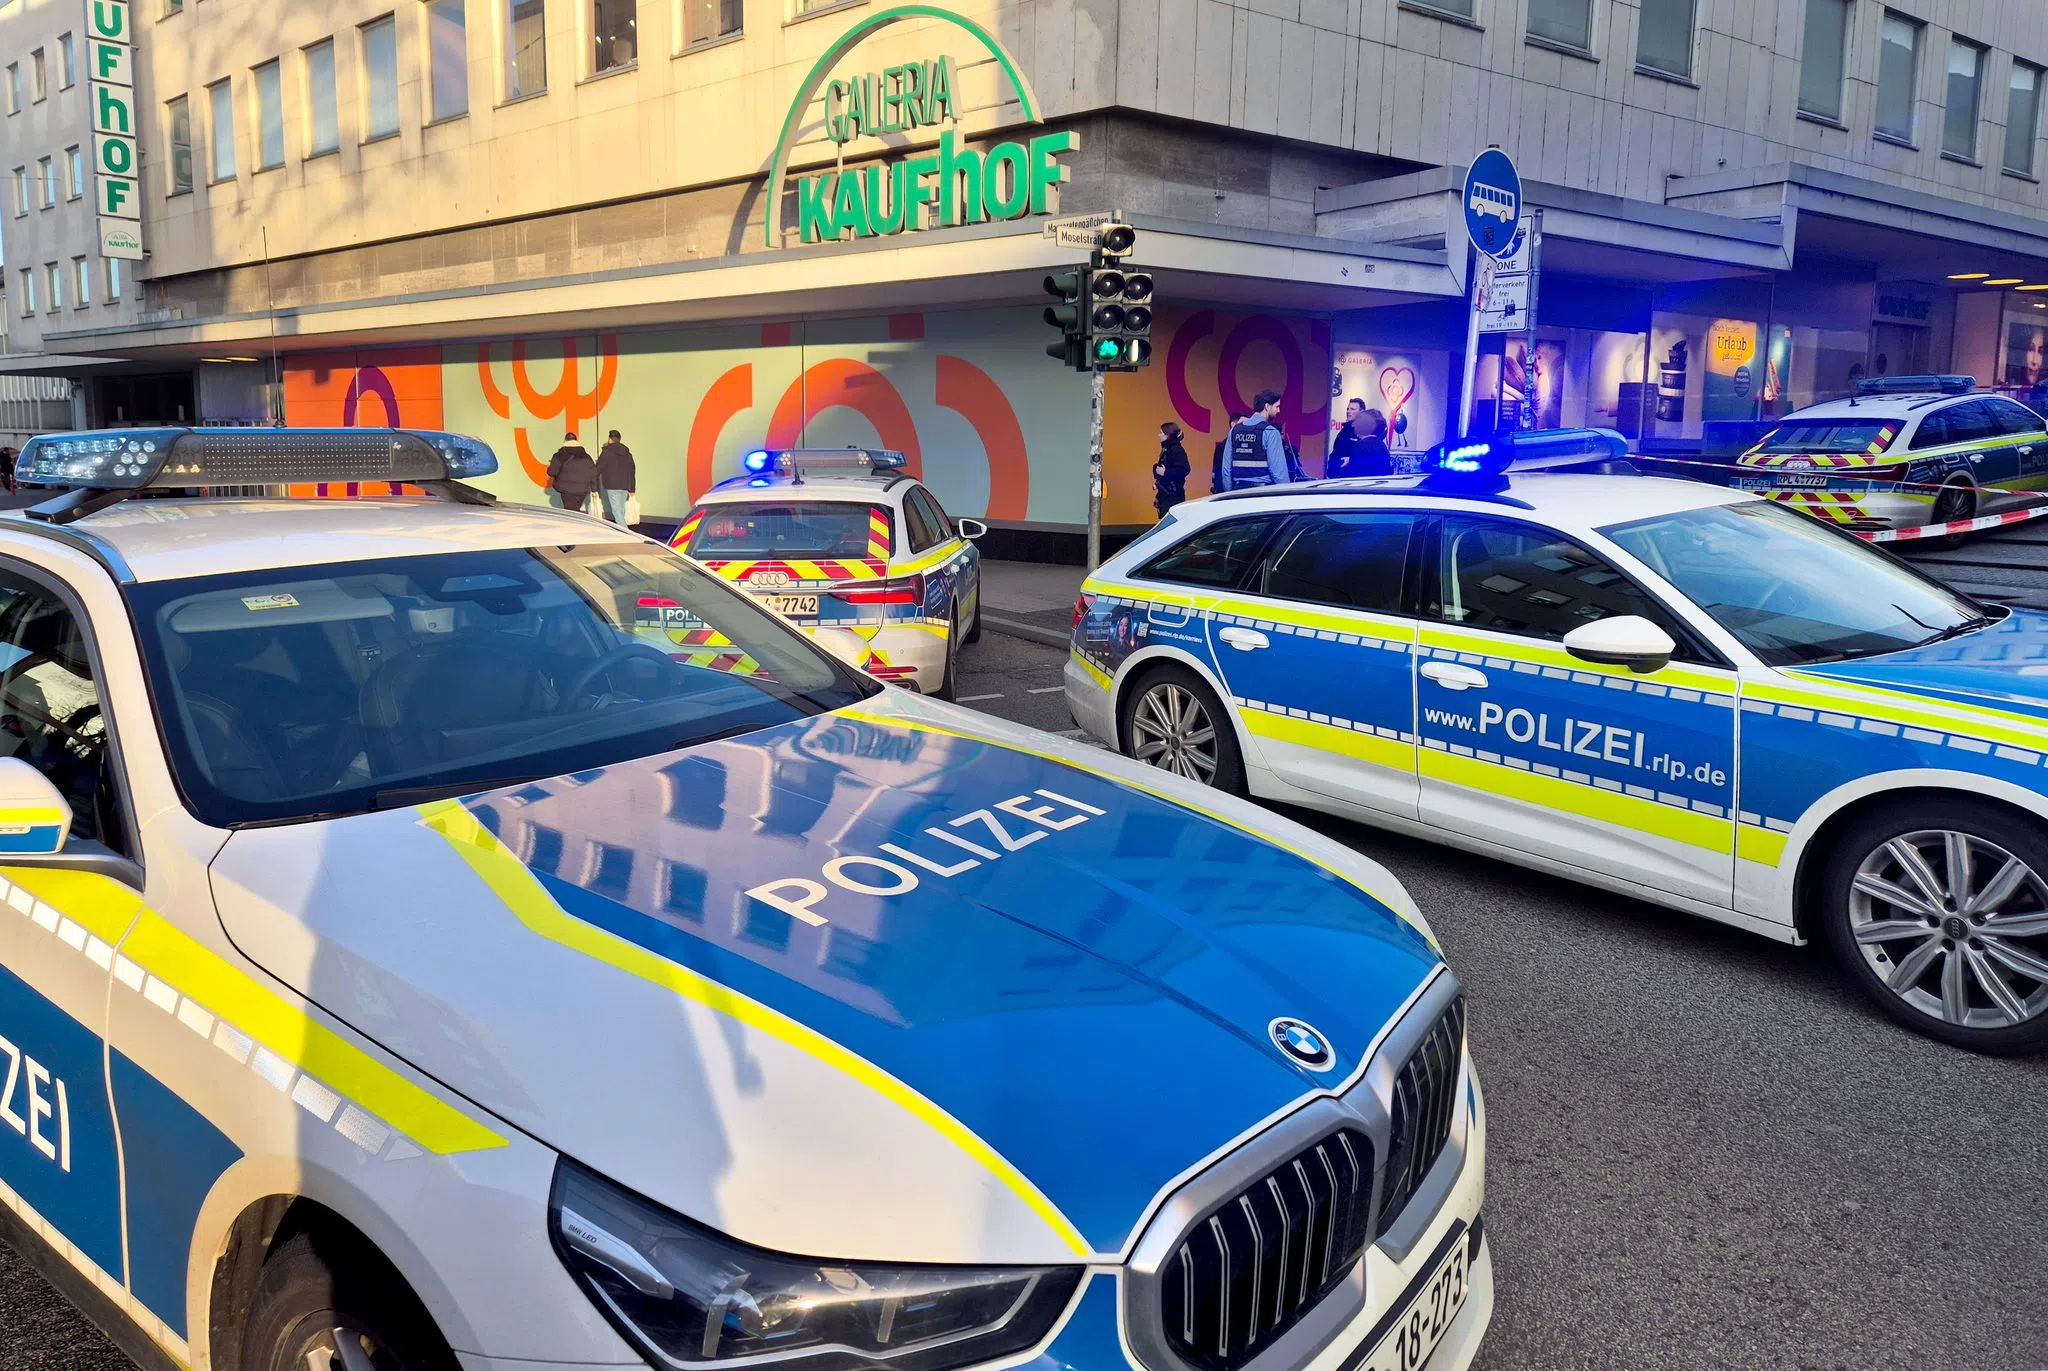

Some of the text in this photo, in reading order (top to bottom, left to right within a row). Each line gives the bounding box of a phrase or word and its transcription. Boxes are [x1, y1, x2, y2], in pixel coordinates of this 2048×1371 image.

[825, 55, 956, 142] GALERIA
[1717, 336, 1747, 351] Urlaub
[1235, 433, 1256, 442] POLIZEI
[1743, 479, 1771, 487] POLIZEI
[782, 597, 817, 613] 7742
[1424, 701, 1727, 787] www.POLIZEI.rlp.de
[743, 788, 1108, 928] POLIZEI
[567, 1224, 597, 1244] BMW LED
